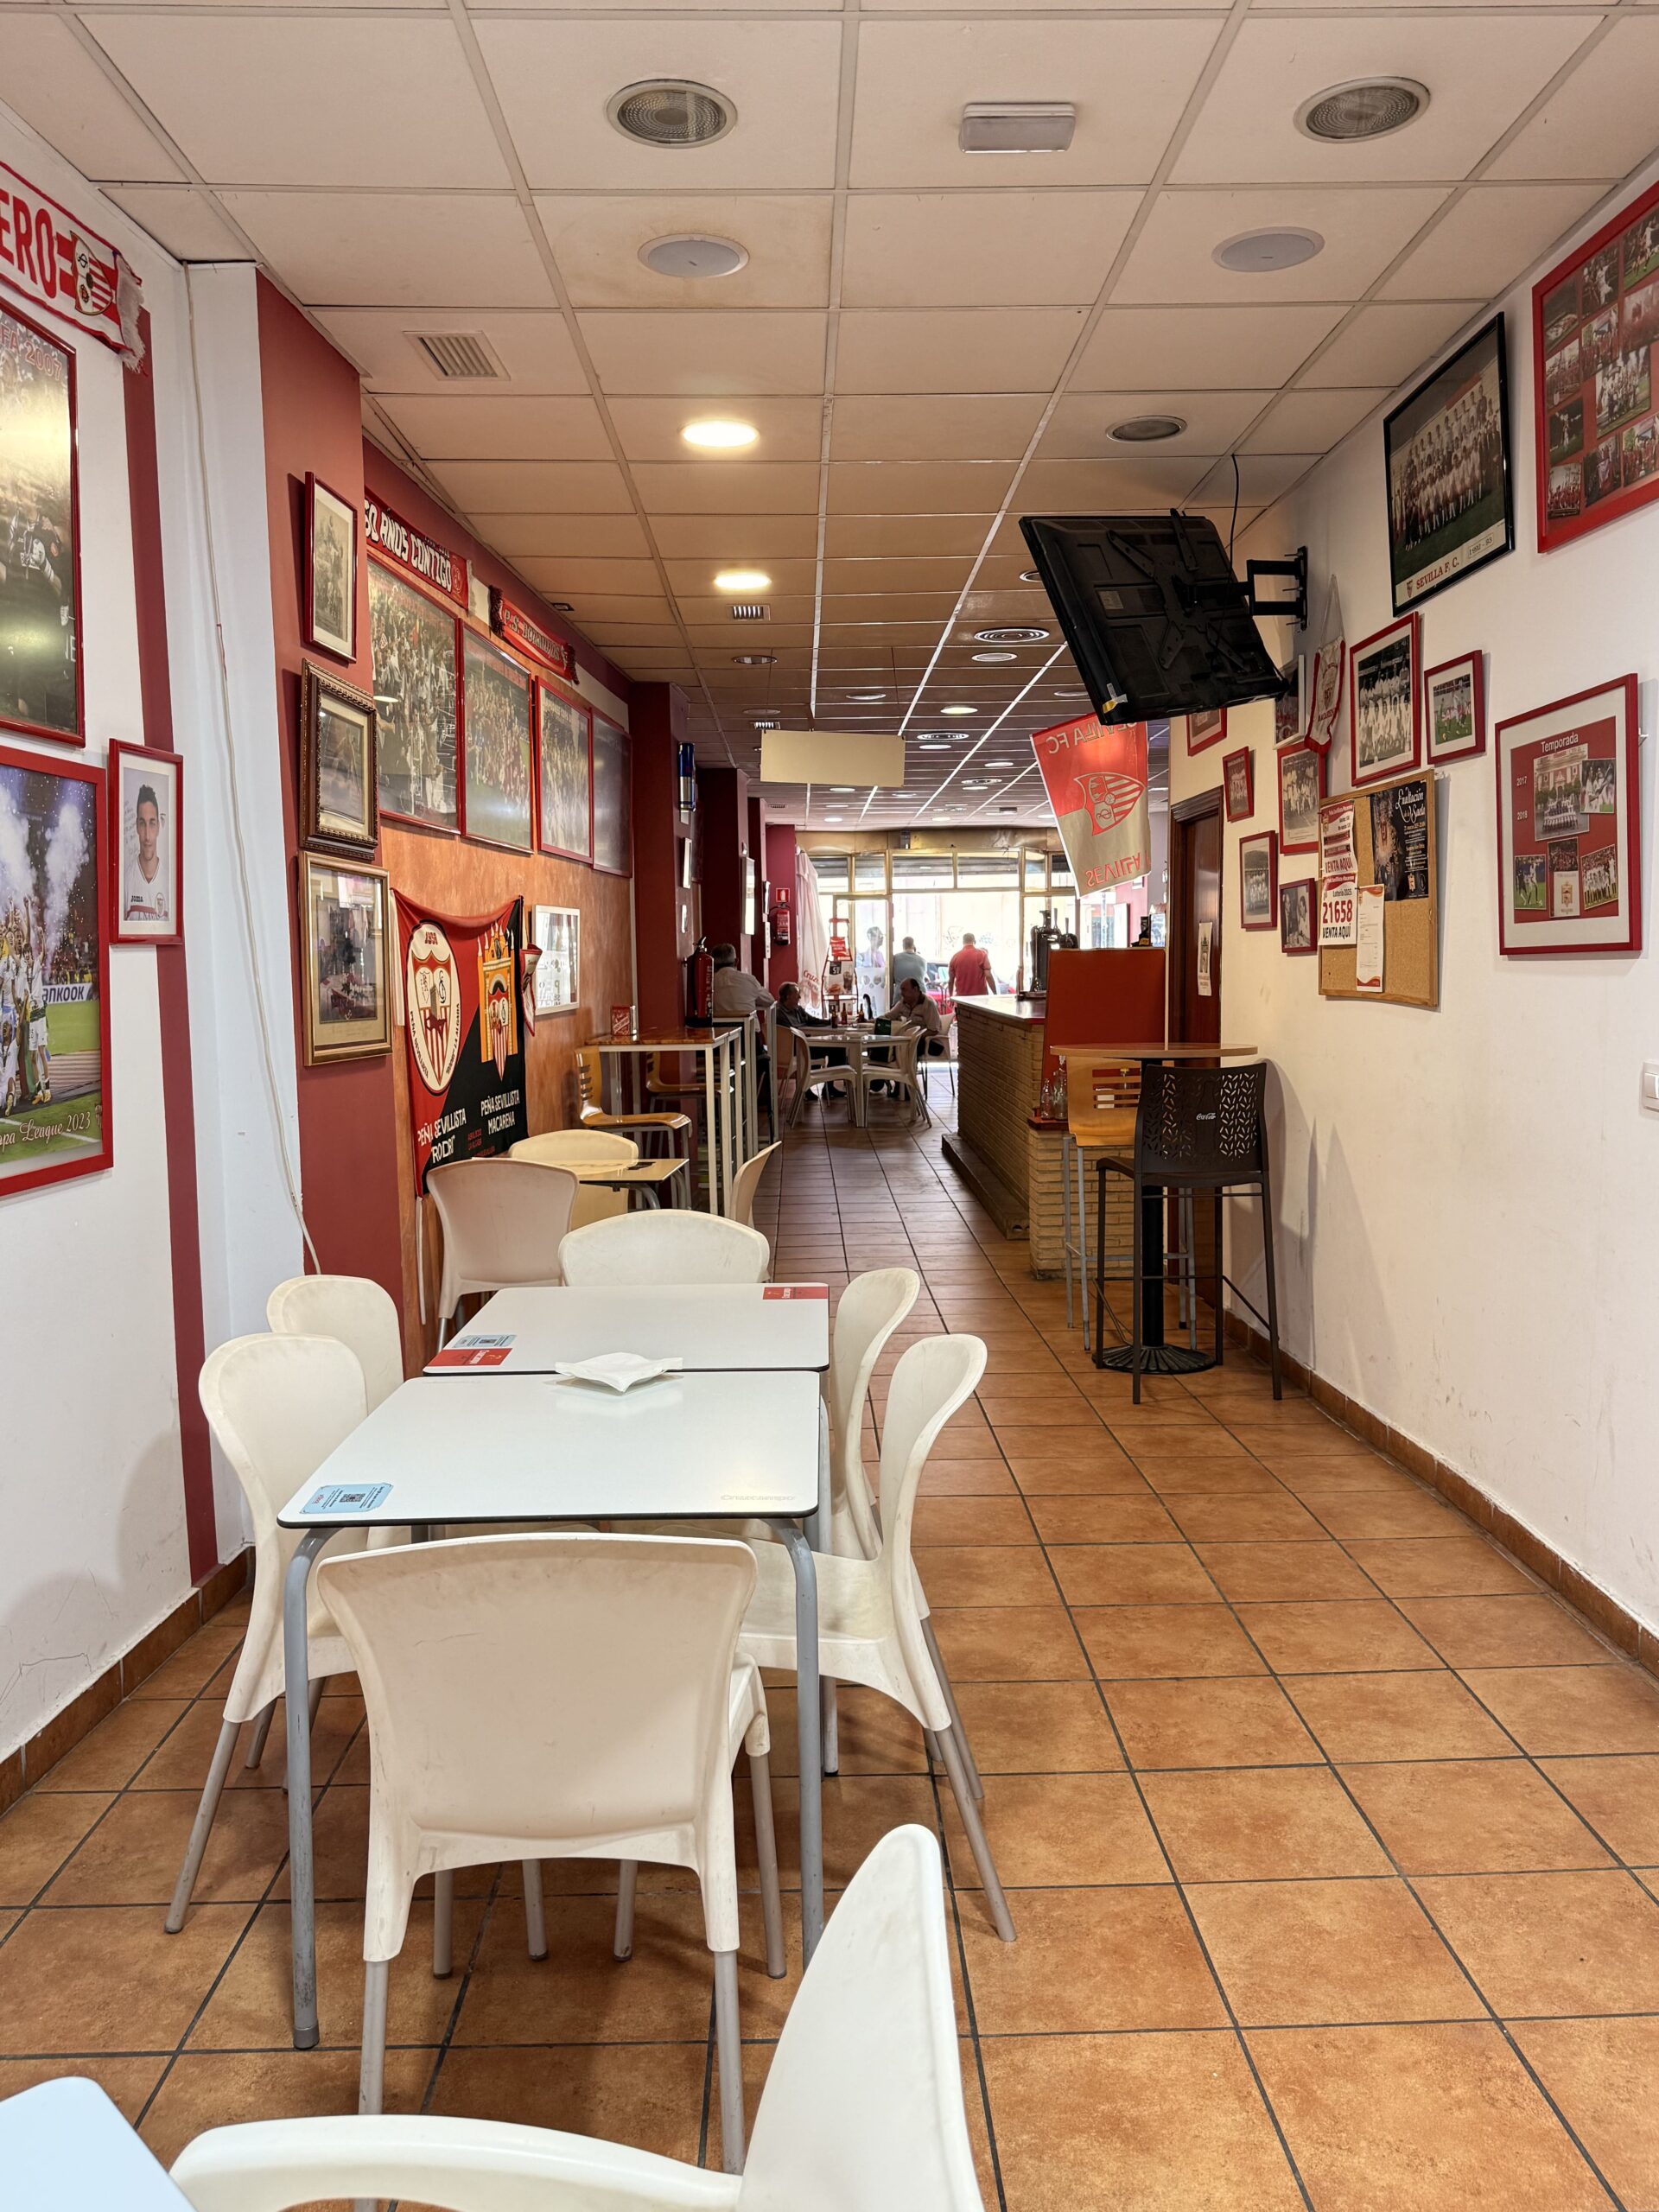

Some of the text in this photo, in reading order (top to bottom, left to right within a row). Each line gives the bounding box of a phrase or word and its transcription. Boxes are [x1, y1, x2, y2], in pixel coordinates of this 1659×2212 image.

[24, 340, 62, 381] 2007
[410, 532, 452, 594] CONTIGO
[1416, 566, 1443, 589] SEVILLA
[1452, 556, 1459, 568] C.
[1541, 733, 1580, 753] Temporada
[1516, 776, 1528, 786] 2017
[1516, 810, 1528, 821] 2018
[1325, 859, 1340, 874] VENTA
[1322, 899, 1353, 924] 21658
[1322, 926, 1338, 938] VENTA
[480, 1090, 520, 1117] PEÑA SEVILLISTA
[20, 1119, 63, 1144] League
[66, 1111, 91, 1133] 2023
[434, 1108, 467, 1139] SEVILLISTA
[487, 1111, 516, 1135] MACARENA
